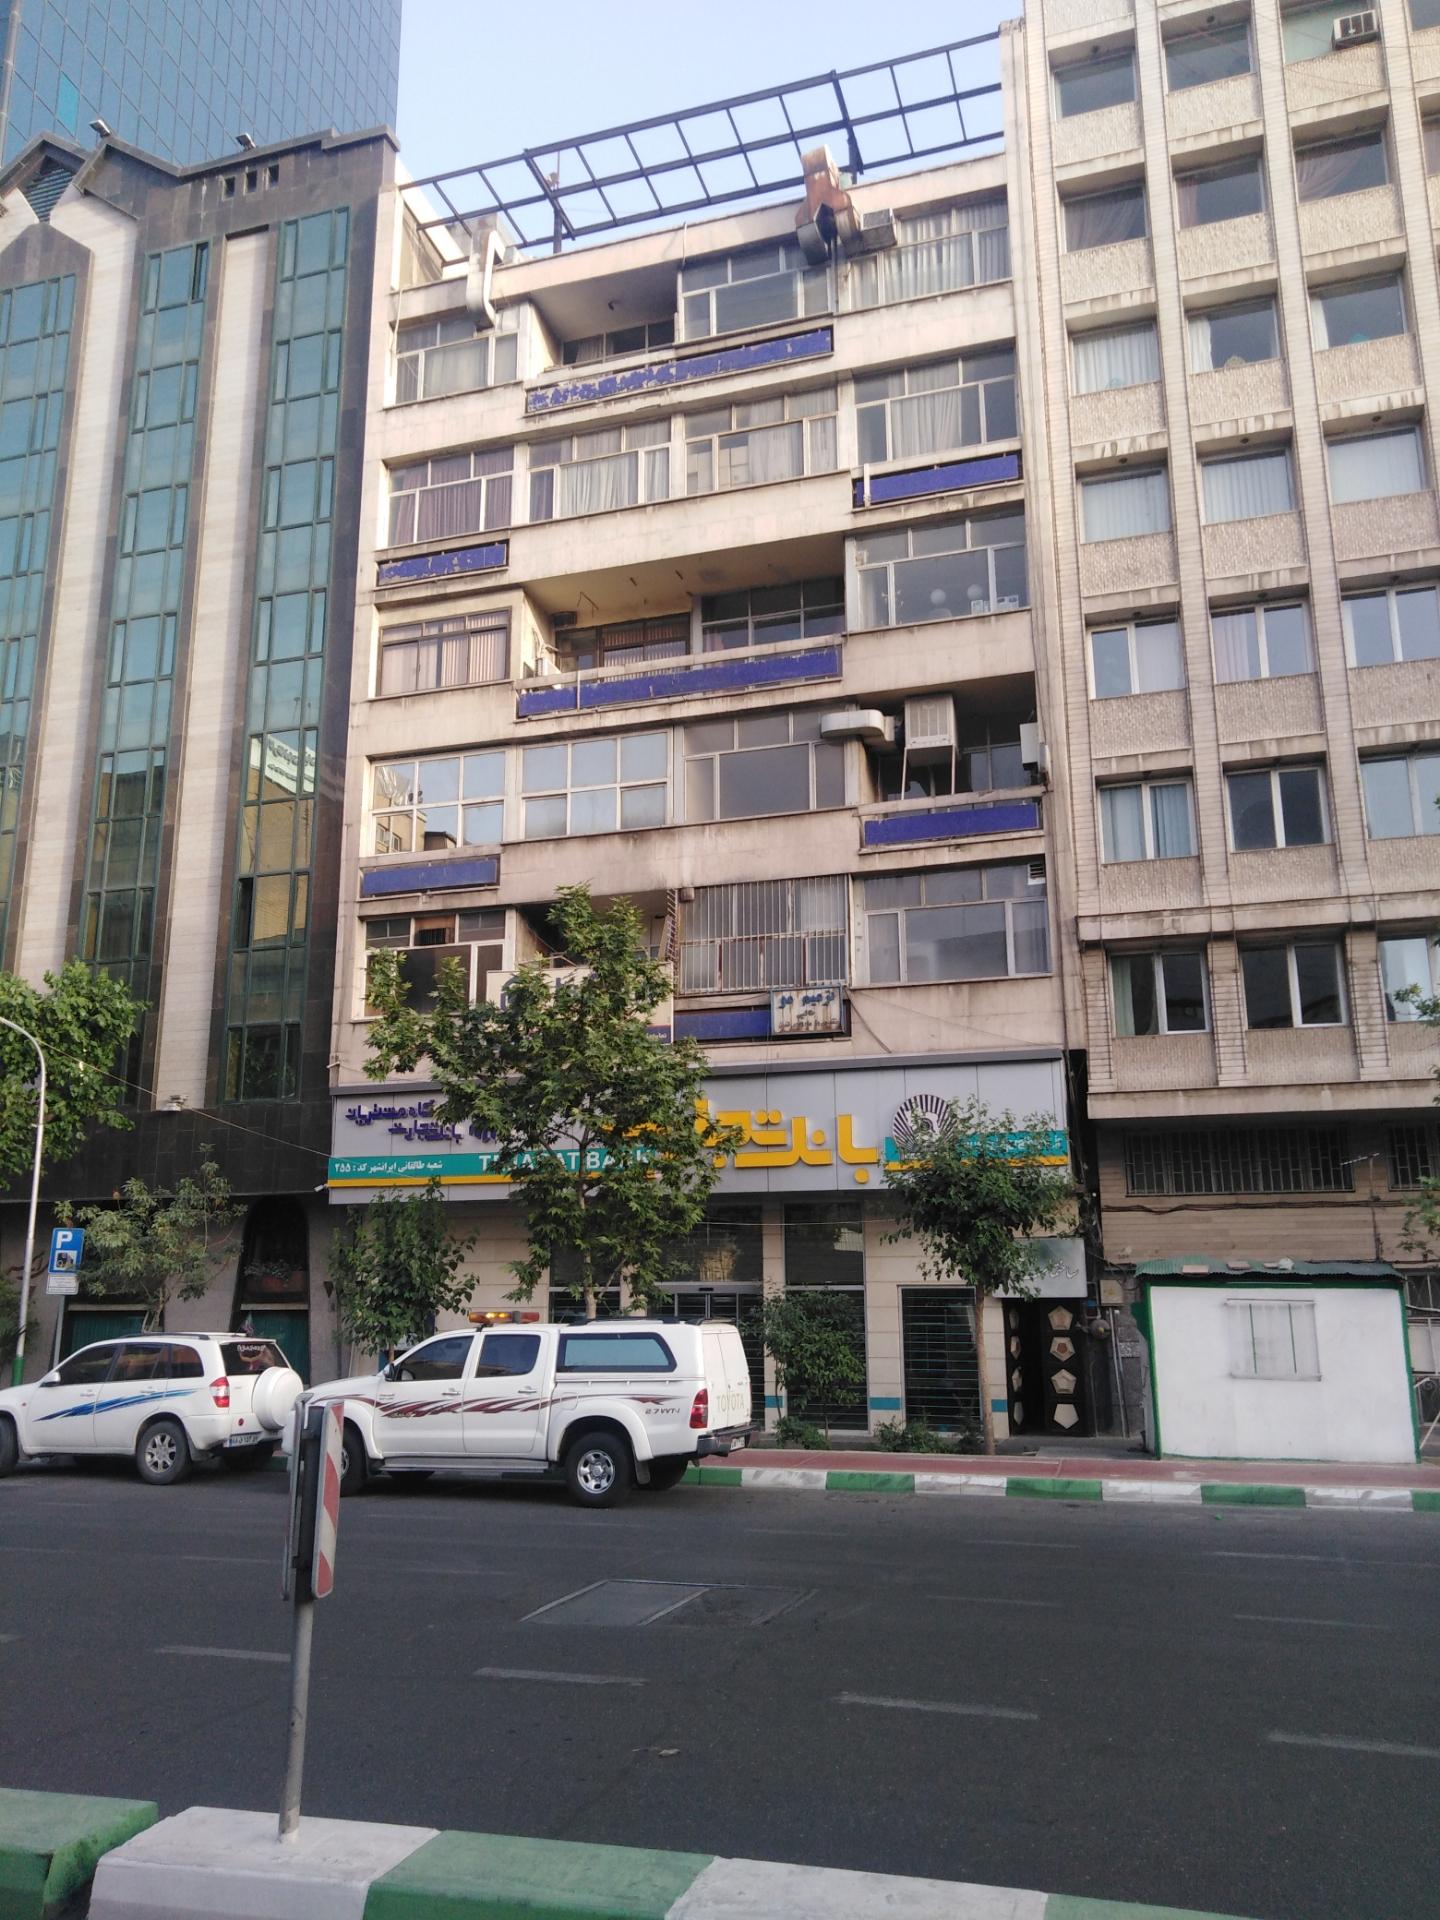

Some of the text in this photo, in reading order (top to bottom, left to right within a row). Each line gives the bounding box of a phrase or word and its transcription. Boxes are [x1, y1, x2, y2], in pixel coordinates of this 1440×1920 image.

[734, 1114, 879, 1184] بانک
[56, 1231, 73, 1249] P
[717, 1391, 745, 1413] TOYOTA
